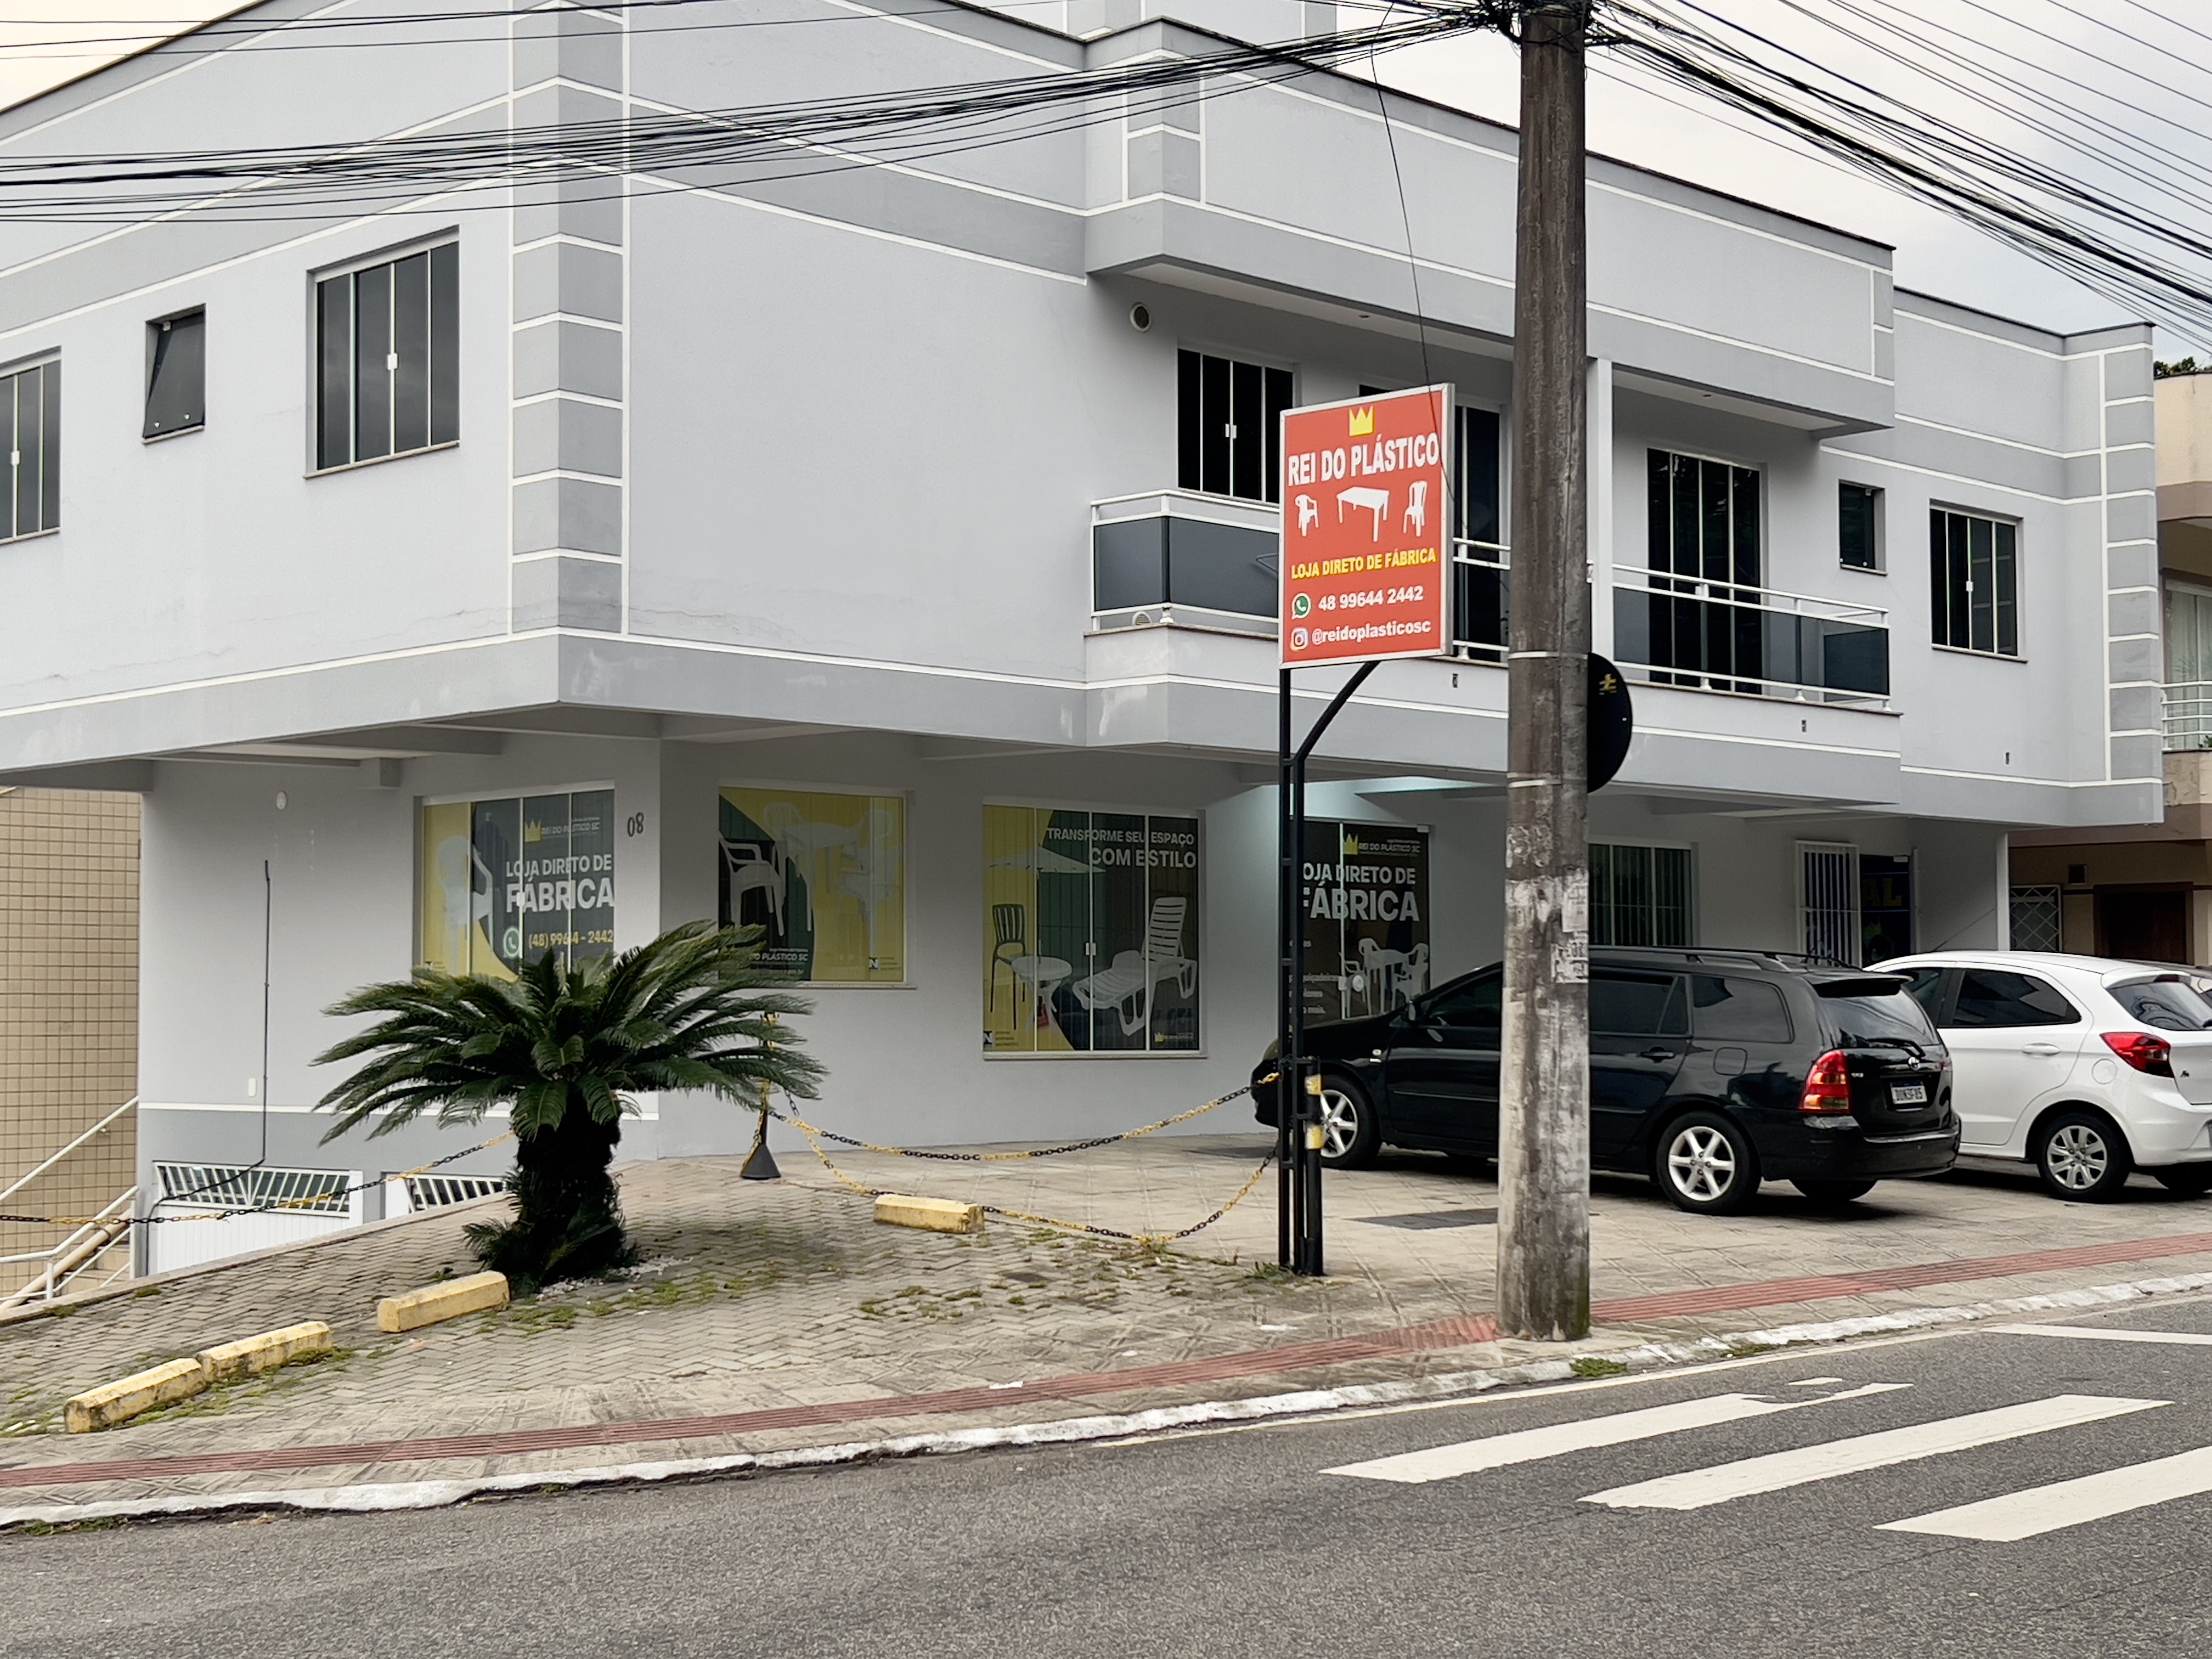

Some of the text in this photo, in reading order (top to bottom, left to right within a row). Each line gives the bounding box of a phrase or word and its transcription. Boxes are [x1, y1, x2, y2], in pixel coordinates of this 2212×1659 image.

[1288, 433, 1439, 486] REI DO PLÁSTICO
[1291, 548, 1436, 579] LOJA DIRETO DE FÁBRICA
[1318, 585, 1423, 611] 48 99644 2442
[1312, 620, 1431, 645] @reidoplasticosc
[627, 812, 644, 837] 08
[1047, 827, 1123, 842] TRANSFORME
[1151, 831, 1195, 848] ESPAÇO
[506, 860, 539, 877] LOJA
[594, 854, 612, 871] DE
[1090, 847, 1196, 868] COM ESTILO
[1303, 862, 1415, 885] OJA DIRETO DE
[506, 875, 614, 913] FÁBRICA
[529, 933, 548, 949] (48)
[550, 931, 579, 945] 9964
[588, 930, 614, 944] 2442
[762, 951, 798, 961] PLÁSTICO
